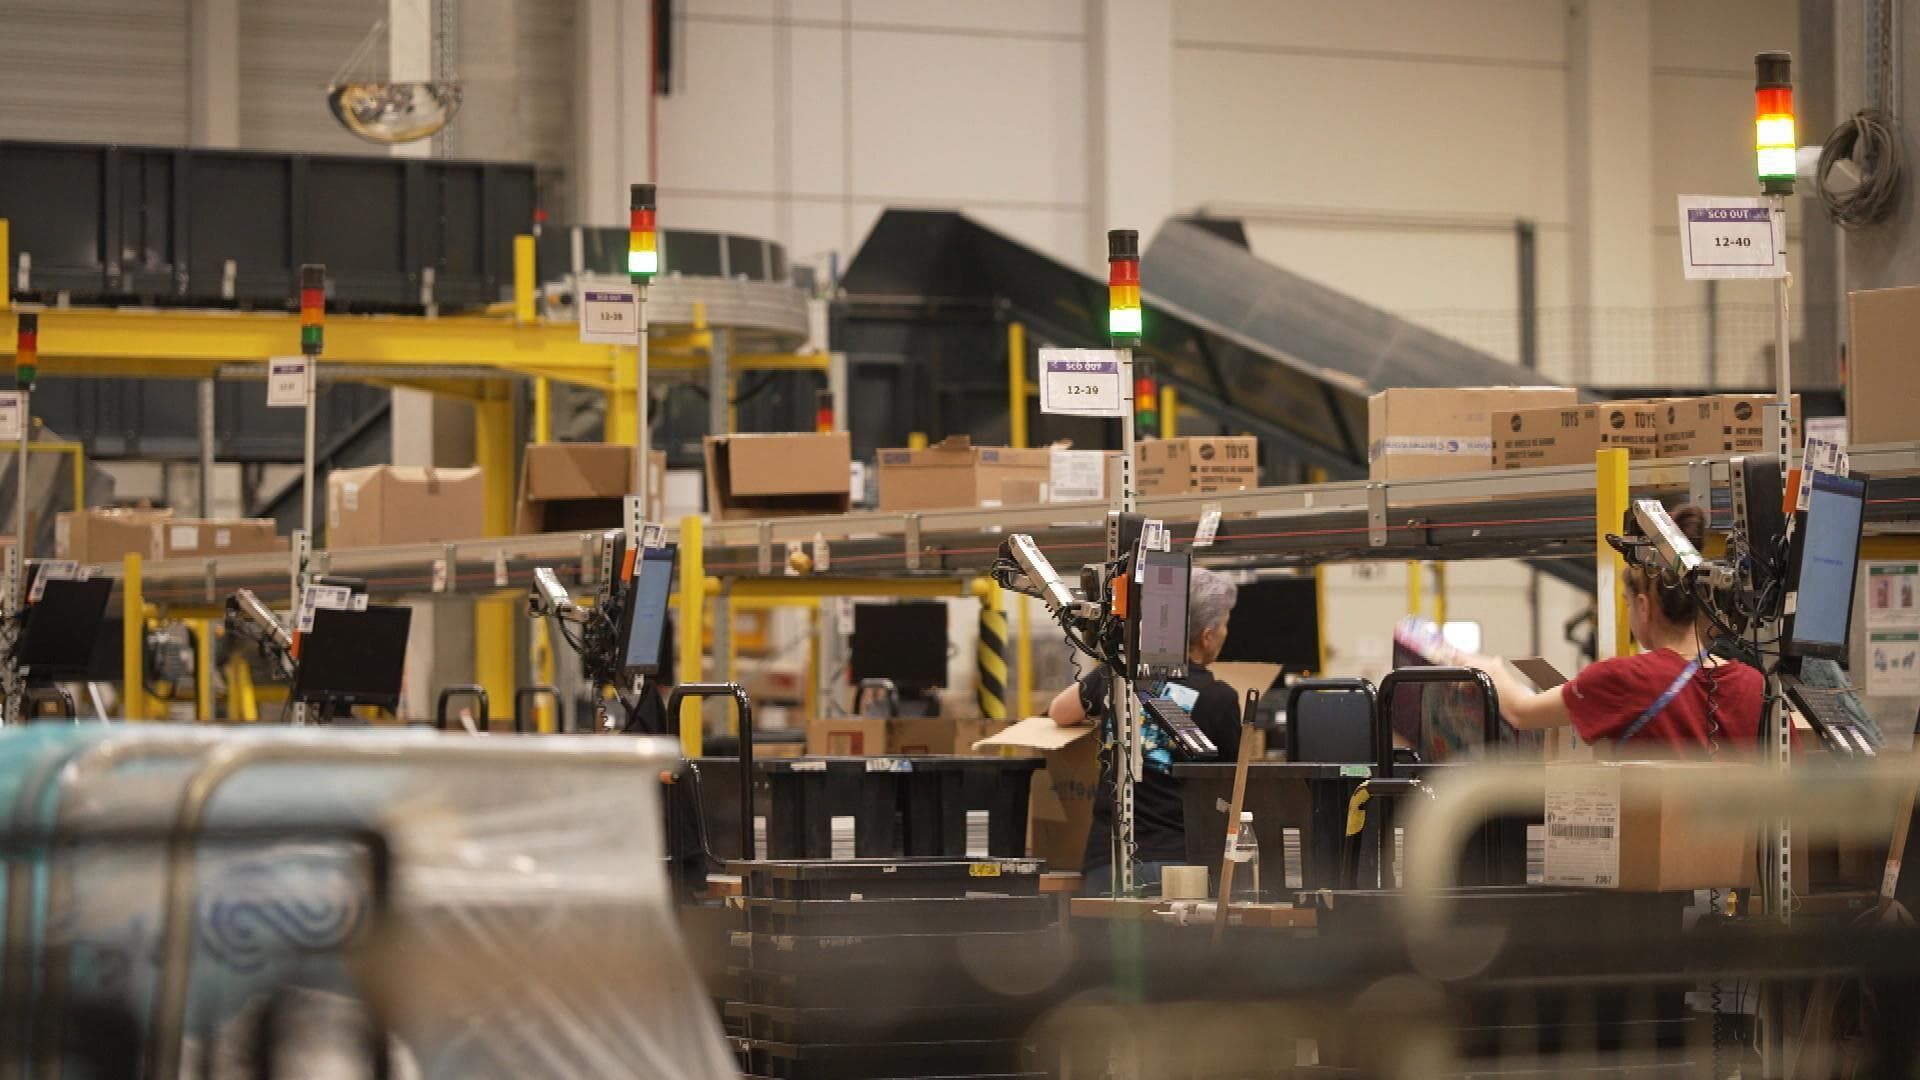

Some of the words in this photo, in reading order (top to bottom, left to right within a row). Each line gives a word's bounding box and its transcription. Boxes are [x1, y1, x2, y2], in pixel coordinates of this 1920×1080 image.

[1708, 209, 1727, 219] SCO
[1729, 209, 1749, 219] OUT
[1714, 237, 1751, 247] 12-40
[1067, 385, 1099, 395] 12-39
[1560, 411, 1579, 427] TOYS
[1225, 444, 1250, 459] TOYS
